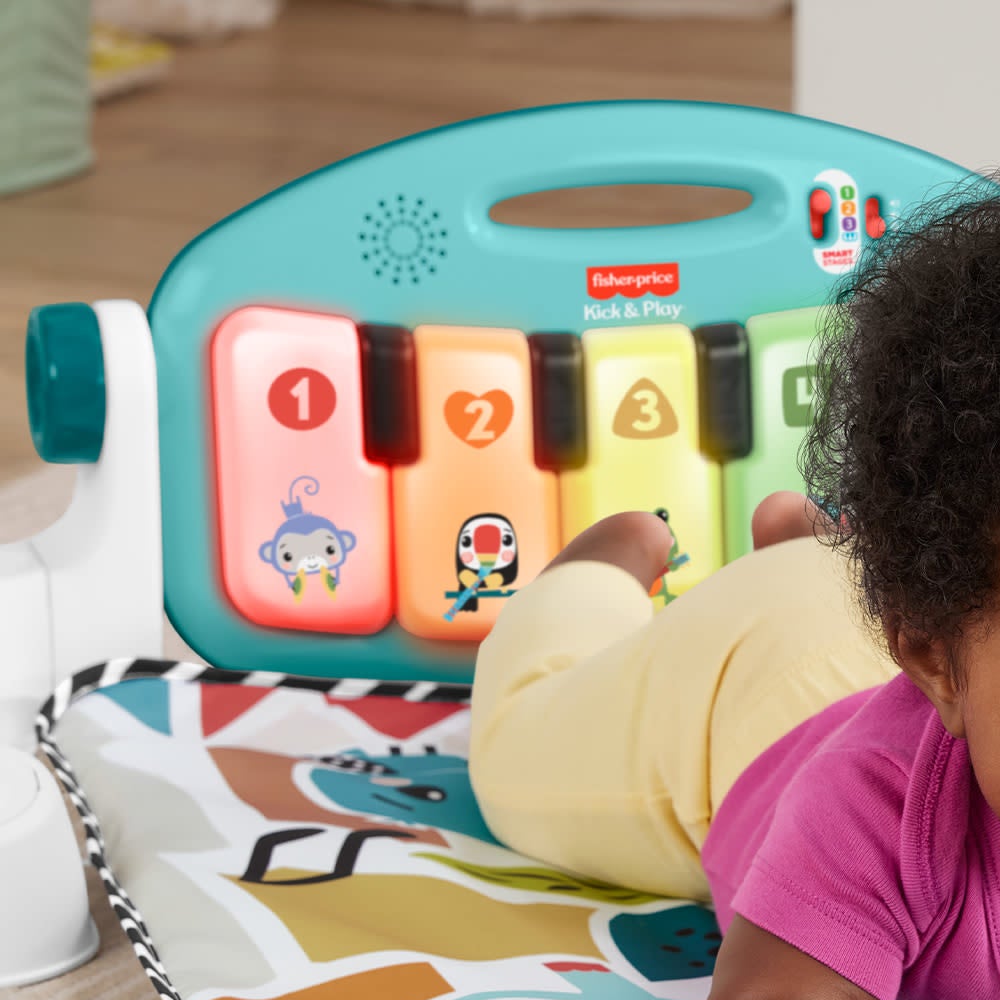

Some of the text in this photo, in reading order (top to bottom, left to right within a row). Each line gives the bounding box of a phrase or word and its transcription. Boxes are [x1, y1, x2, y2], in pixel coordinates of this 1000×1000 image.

[845, 187, 851, 198] 1
[845, 203, 852, 214] 2
[846, 218, 853, 229] 3
[822, 249, 853, 258] SMART
[592, 271, 675, 289] fisher-price
[583, 300, 683, 321] Kick & Play
[289, 376, 312, 422] 1
[632, 388, 661, 431] 3
[464, 400, 495, 441] 2
